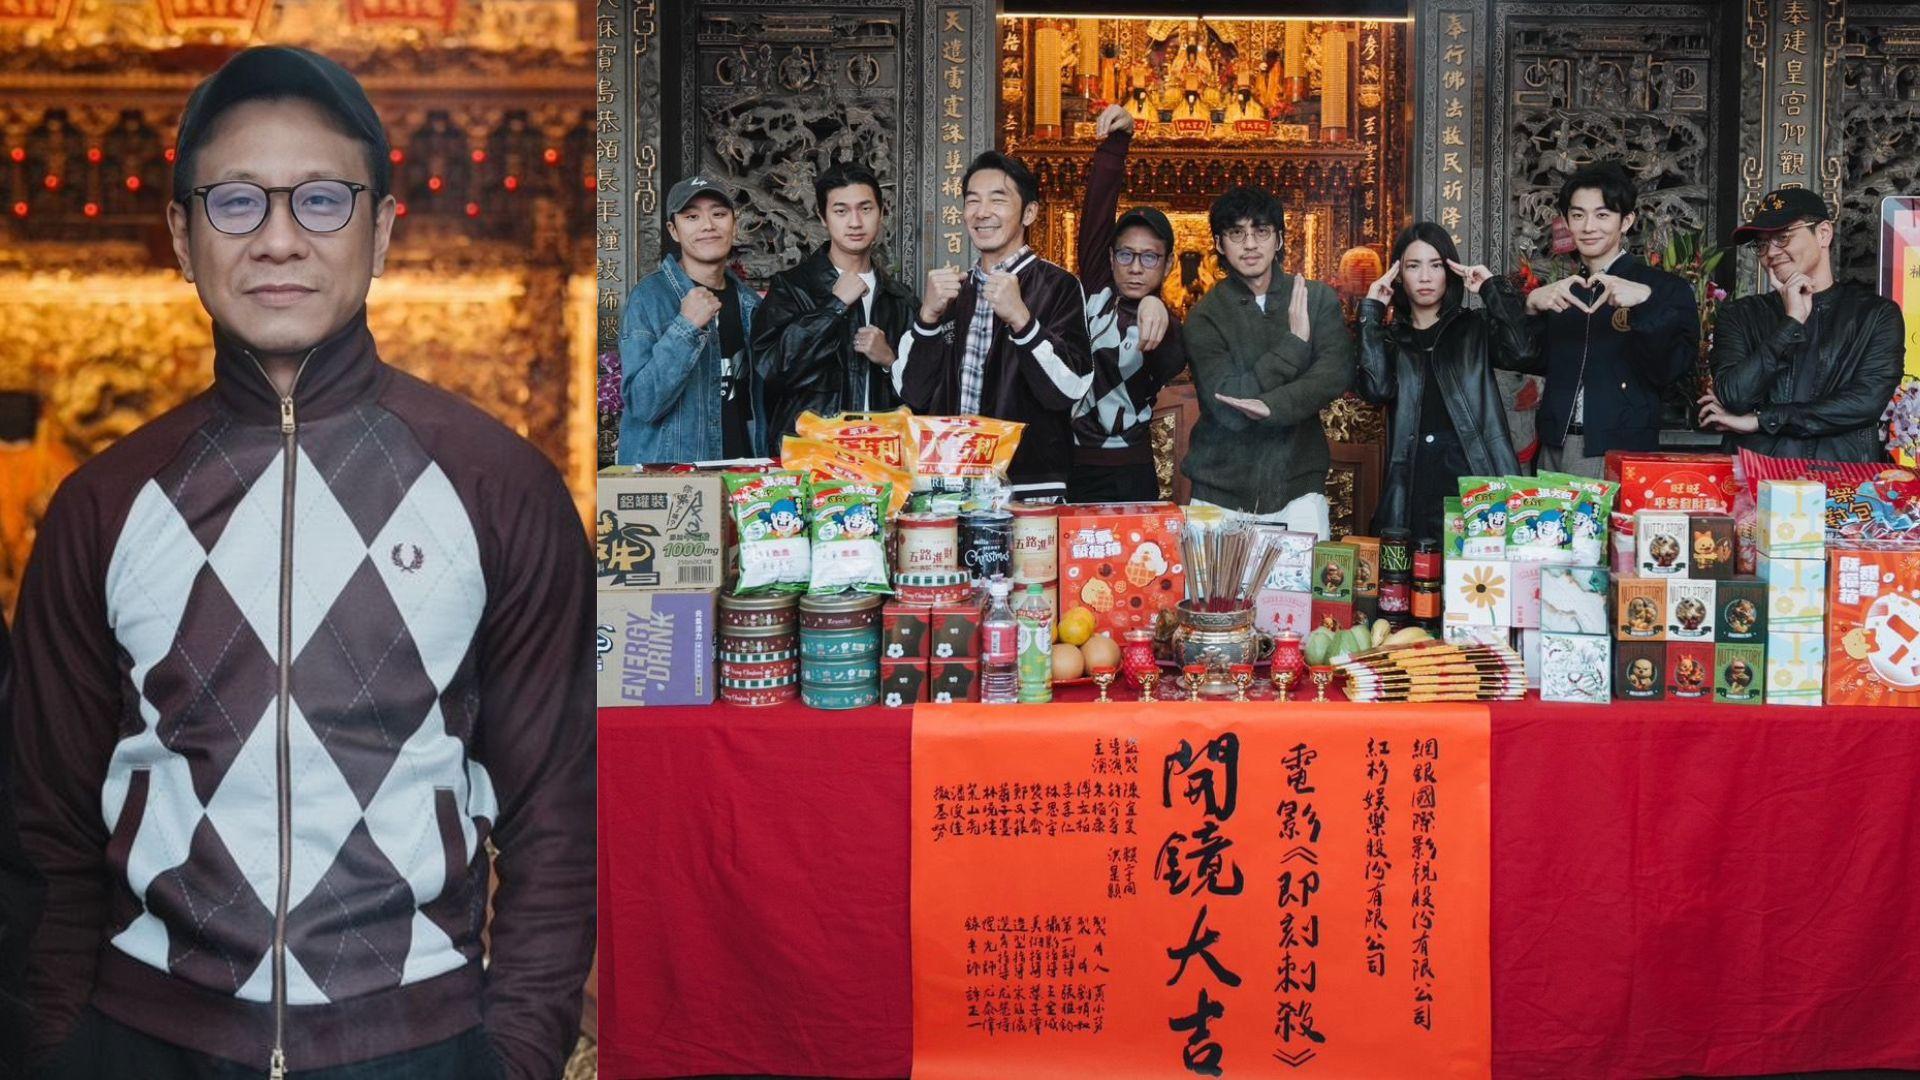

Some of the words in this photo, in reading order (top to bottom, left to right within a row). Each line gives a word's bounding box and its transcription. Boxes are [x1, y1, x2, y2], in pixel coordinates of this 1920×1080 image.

[621, 611, 650, 700] ENERGY
[646, 610, 675, 682] DRINK
[1154, 732, 1244, 1077] 開鏡大吉
[1273, 743, 1325, 1068] 電影《即刻刺殺》
[1362, 737, 1392, 977] 紅杉娛樂股份有限公司
